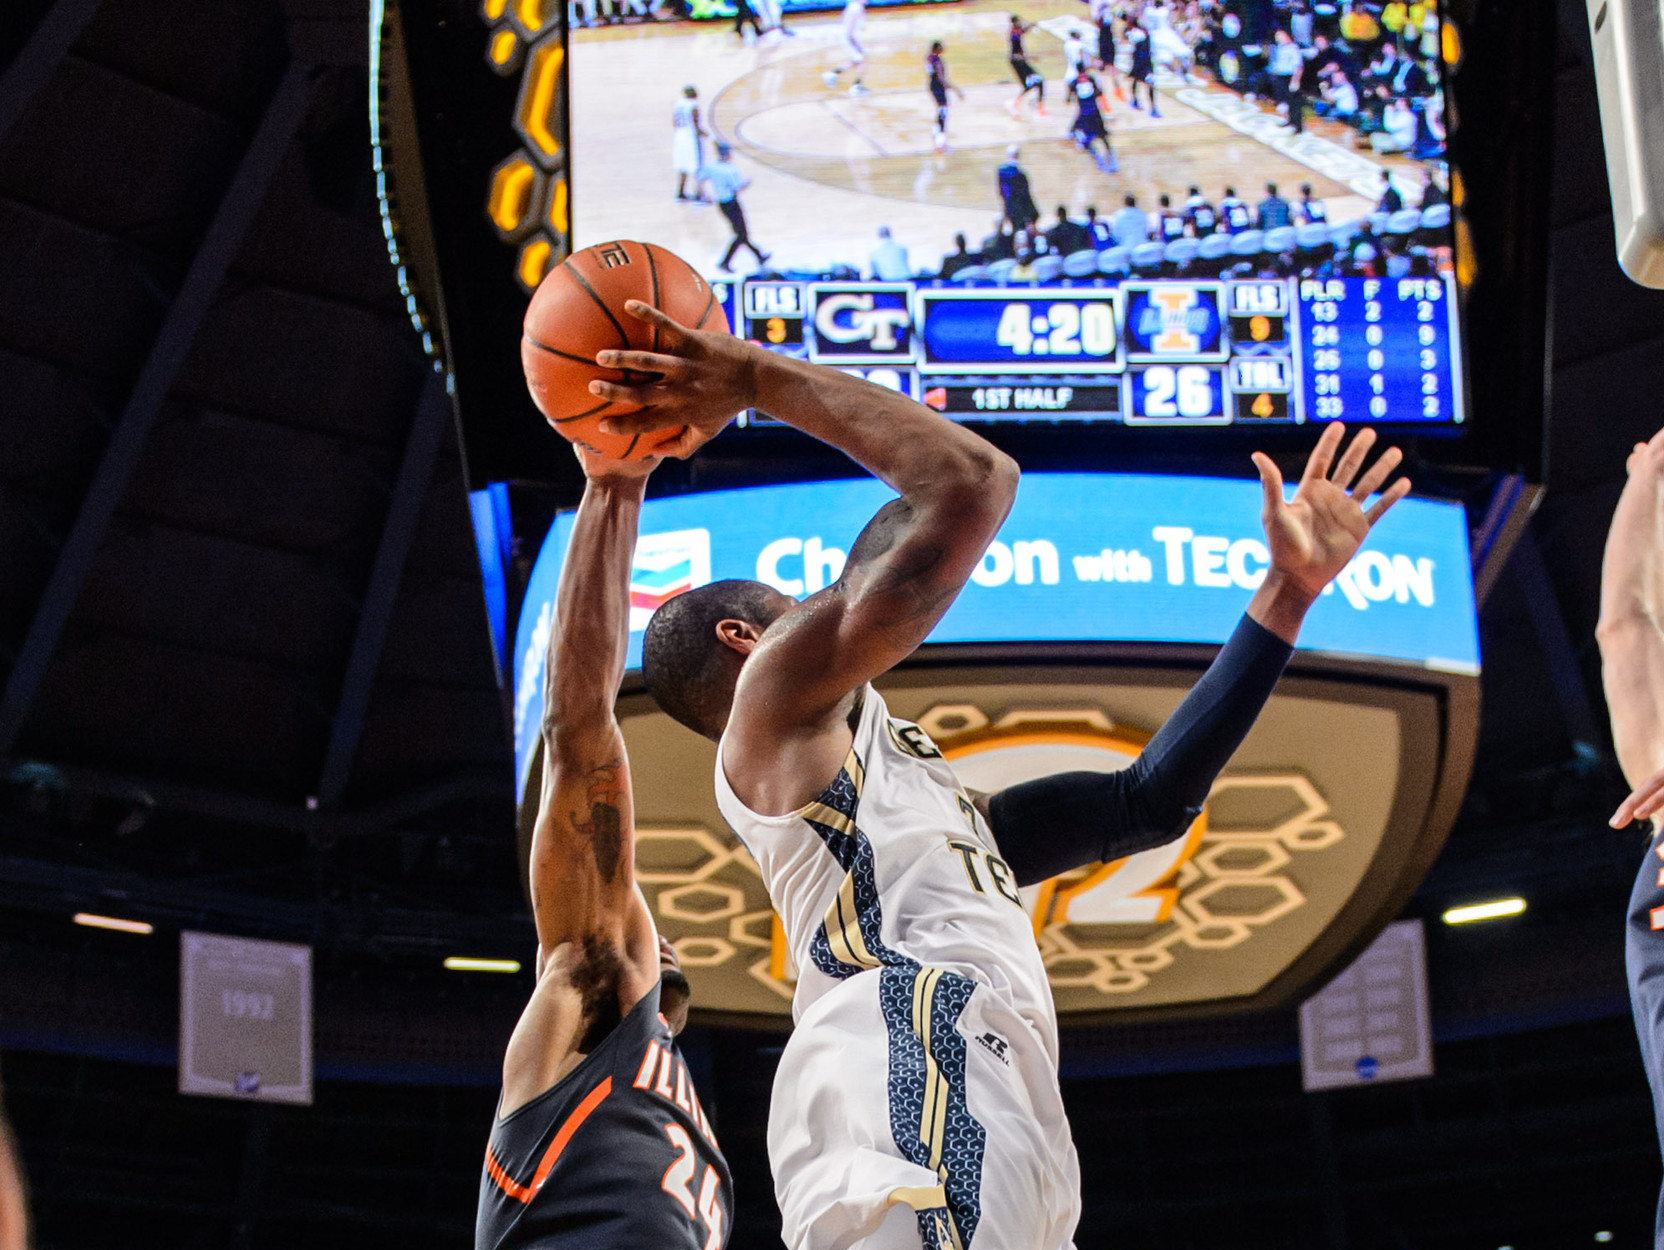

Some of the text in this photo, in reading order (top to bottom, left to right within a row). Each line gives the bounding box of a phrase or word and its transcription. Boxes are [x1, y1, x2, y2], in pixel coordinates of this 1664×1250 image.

[1301, 279, 1442, 301] PLR F PTS
[1311, 301, 1338, 322] 13
[766, 317, 787, 344] 3
[996, 303, 1116, 356] 4:20
[972, 387, 1073, 410] 1ST HALF
[1143, 367, 1212, 417] 26
[756, 526, 1435, 610] Chon with TECON
